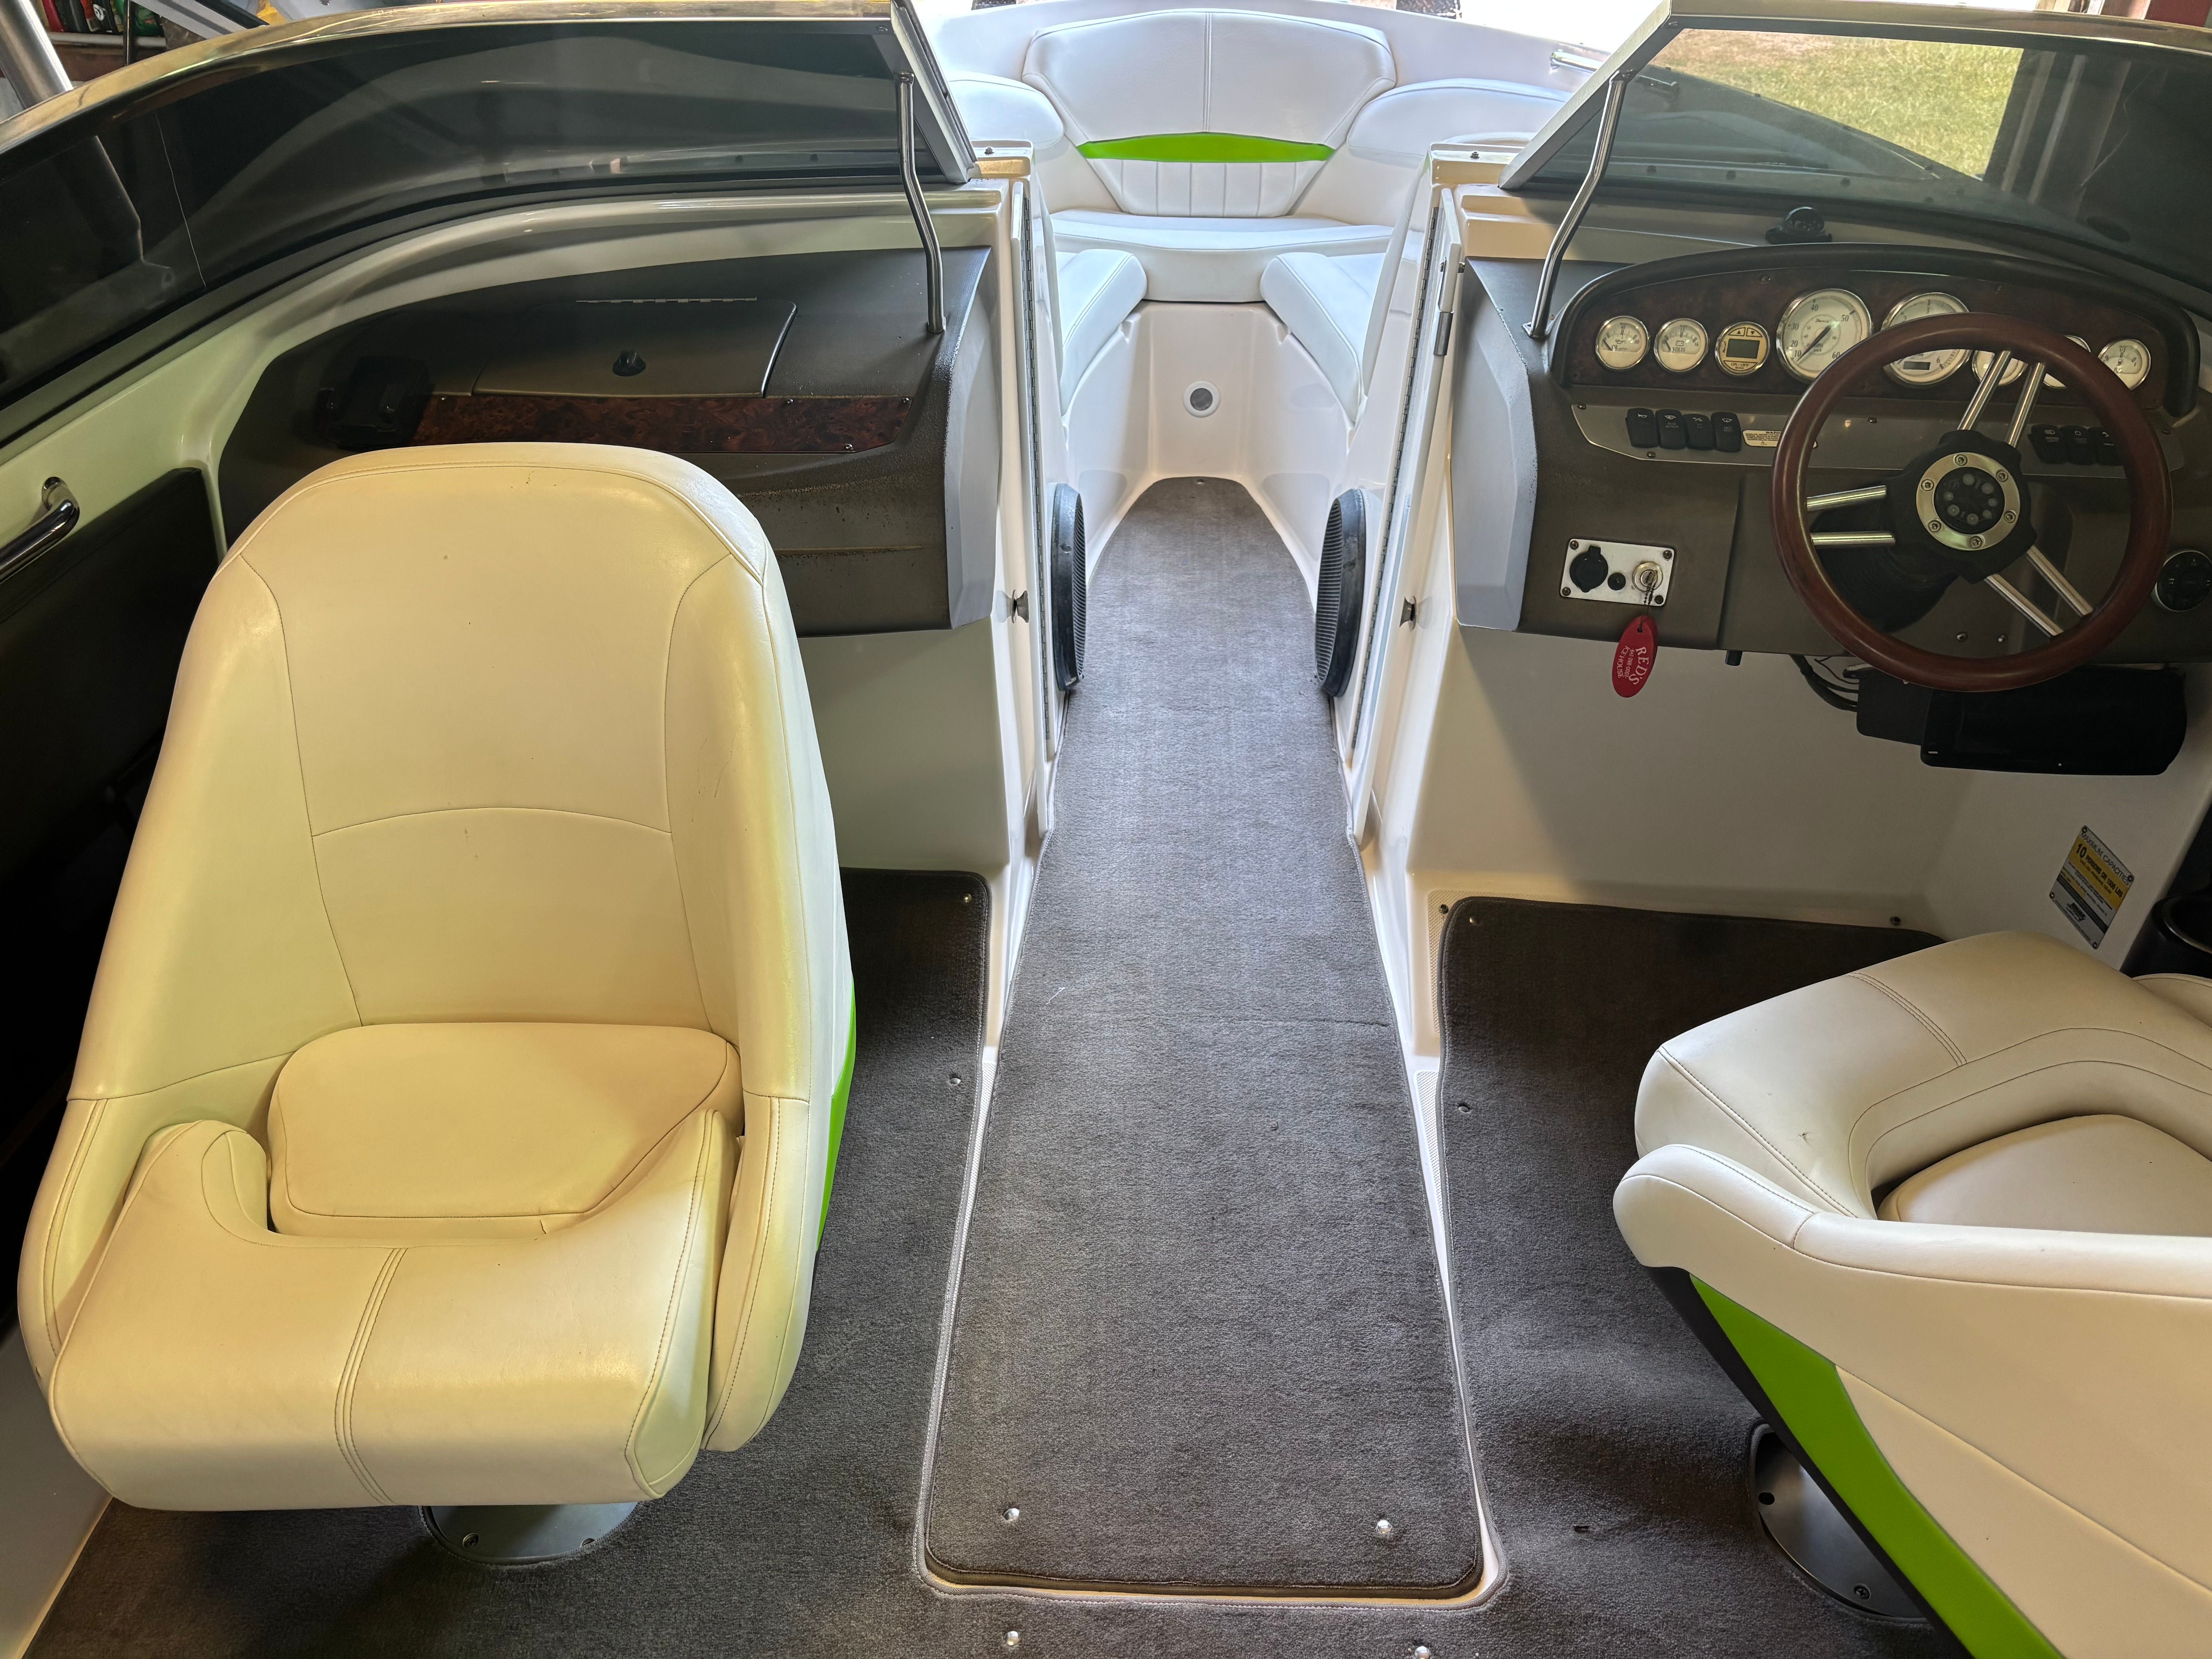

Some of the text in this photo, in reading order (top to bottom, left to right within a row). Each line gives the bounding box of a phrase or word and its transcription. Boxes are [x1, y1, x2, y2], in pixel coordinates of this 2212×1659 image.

[1621, 646, 1630, 656] ICE
[1628, 647, 1649, 685] RED'S
[2076, 843, 2087, 858] 10
[2082, 833, 2103, 857] MAXIMUM
[2103, 855, 2129, 885] CAPACITIES
